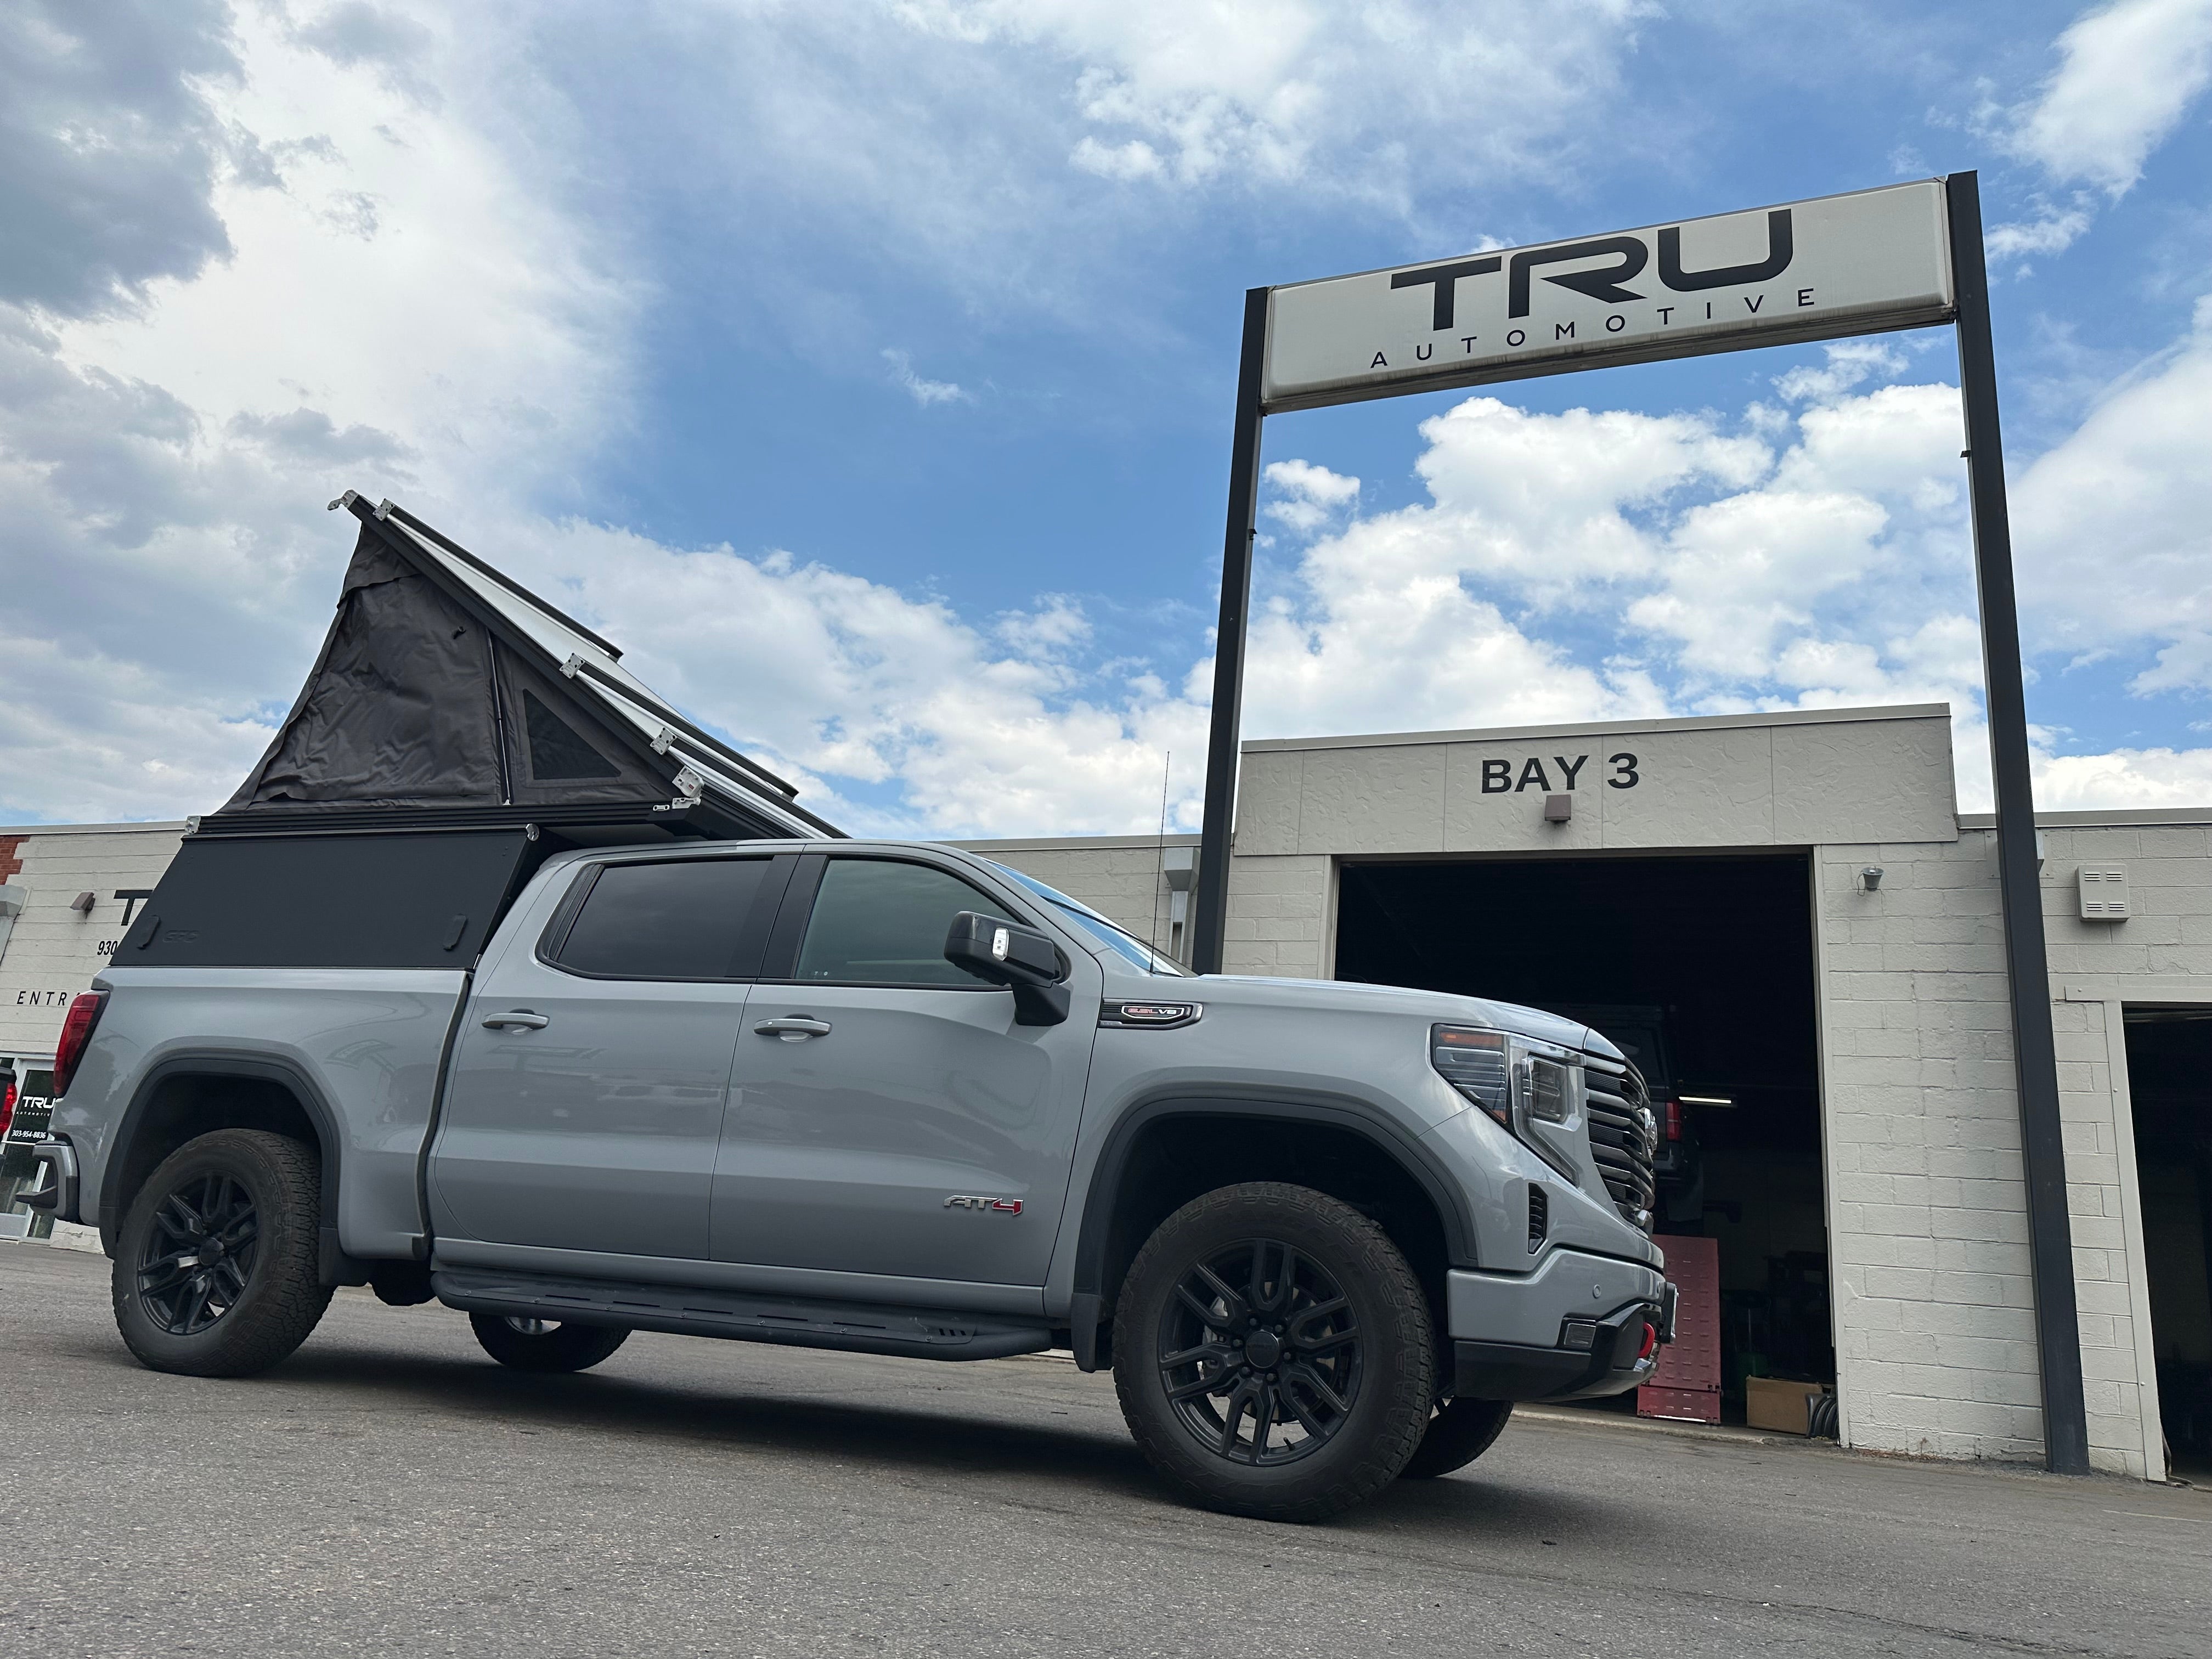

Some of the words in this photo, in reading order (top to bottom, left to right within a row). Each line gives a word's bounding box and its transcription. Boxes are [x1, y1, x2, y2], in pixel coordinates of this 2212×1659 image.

[1390, 208, 1794, 332] TRU
[1369, 287, 1815, 369] AUTOMOTIVE
[1481, 754, 1589, 794] BAY
[1606, 752, 1640, 789] 3
[16, 990, 80, 1006] ENTR
[22, 1096, 57, 1109] TRU
[943, 1194, 1024, 1216] AT4
